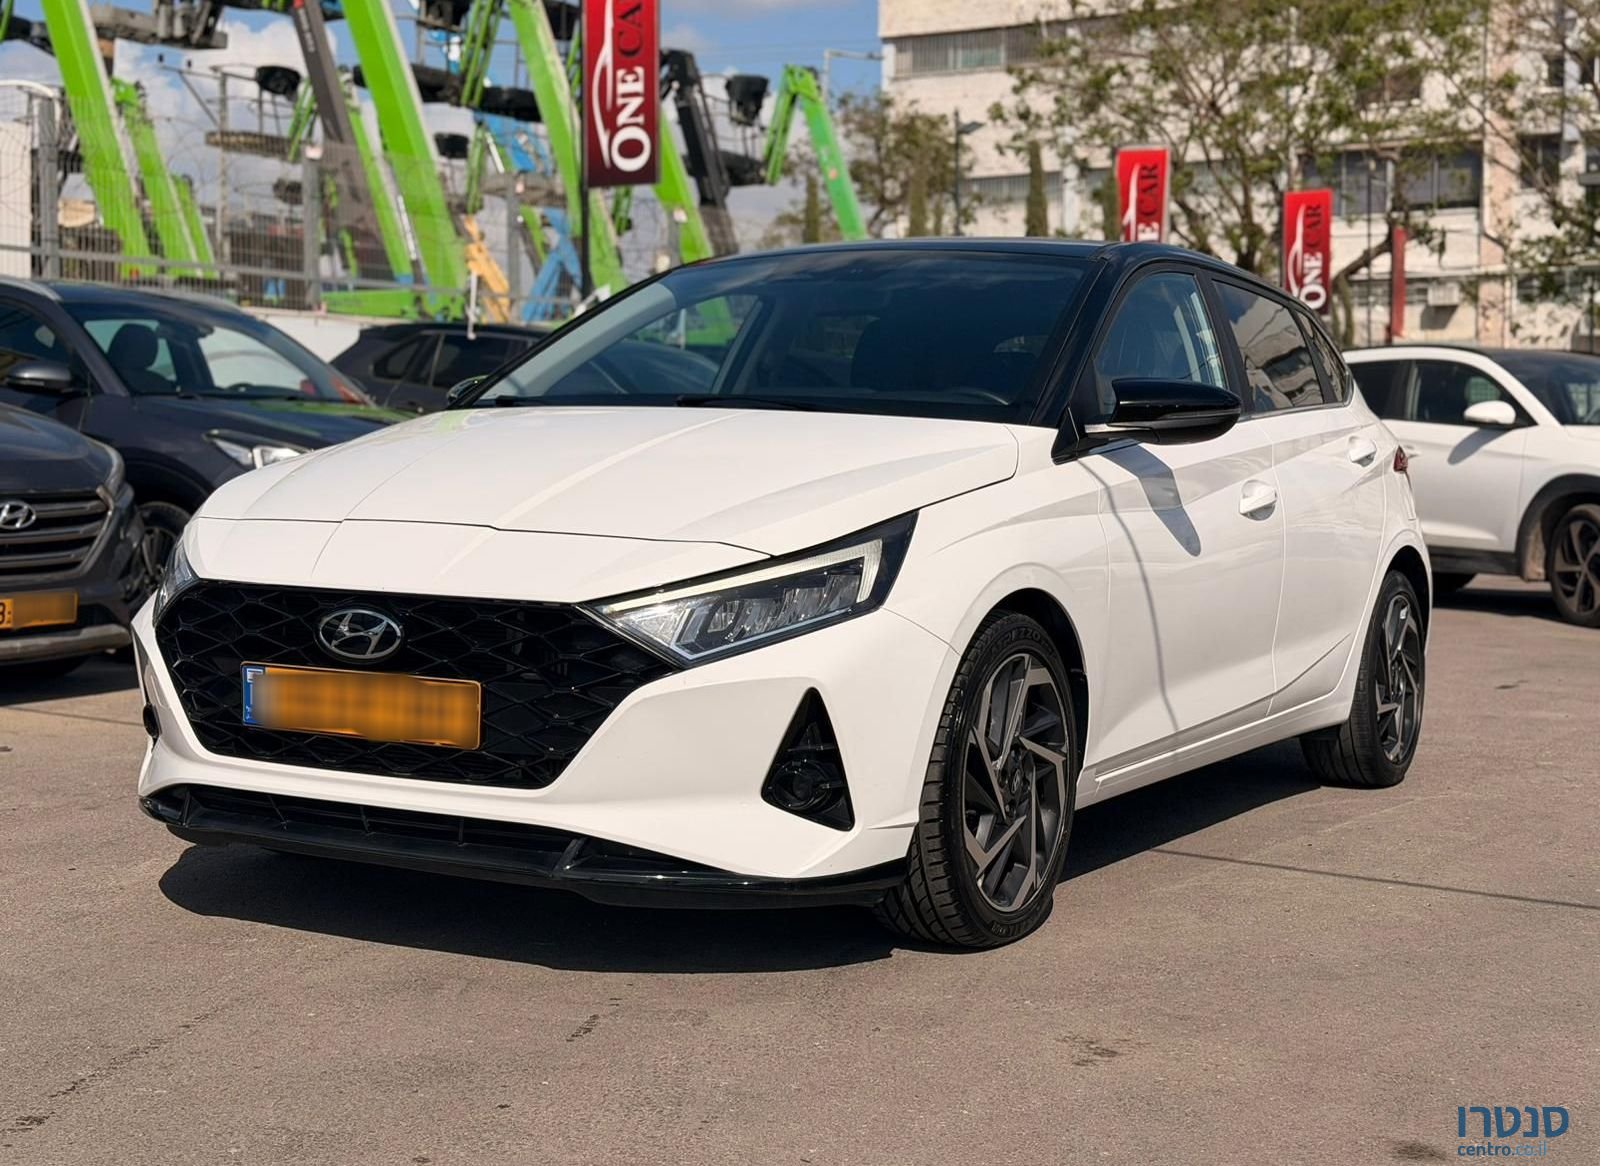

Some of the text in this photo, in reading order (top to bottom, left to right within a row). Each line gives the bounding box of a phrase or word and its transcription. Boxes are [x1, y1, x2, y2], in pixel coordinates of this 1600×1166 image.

[611, 0, 651, 172] ONE CA
[1140, 163, 1159, 217] CAR
[1300, 203, 1327, 310] ONE CAR
